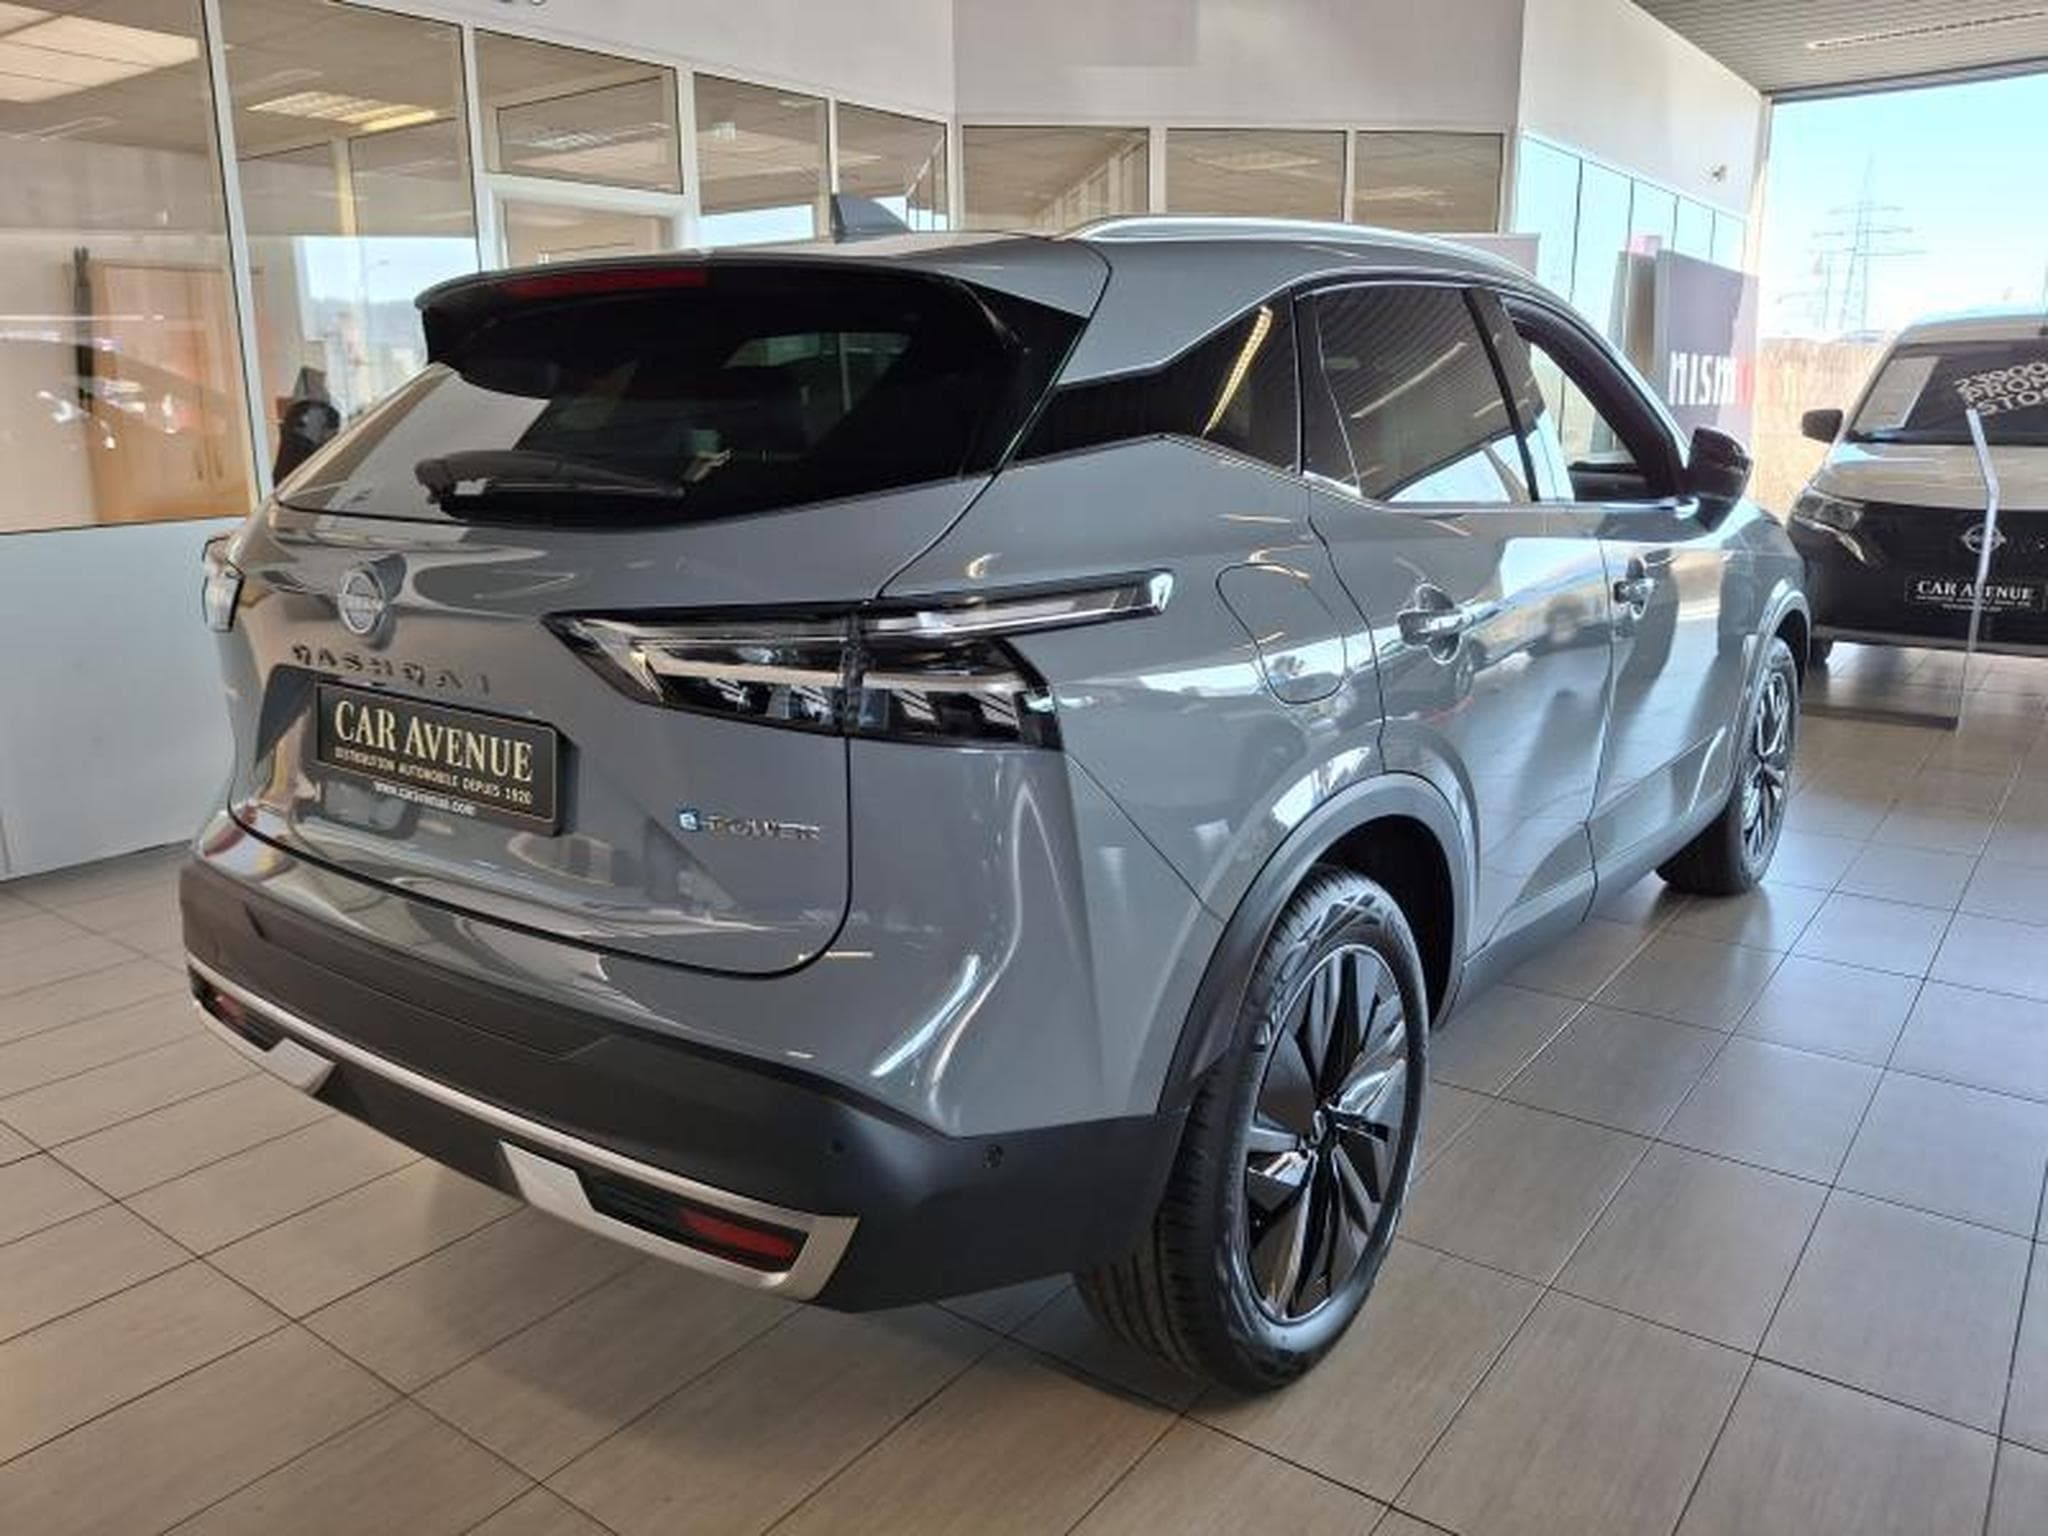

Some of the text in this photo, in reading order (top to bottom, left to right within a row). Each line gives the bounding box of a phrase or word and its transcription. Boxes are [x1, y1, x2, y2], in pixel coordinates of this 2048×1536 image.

[1917, 581, 1957, 596] CAR
[334, 700, 533, 782] CAR AVENUE
[462, 777, 501, 797] DEPUIS
